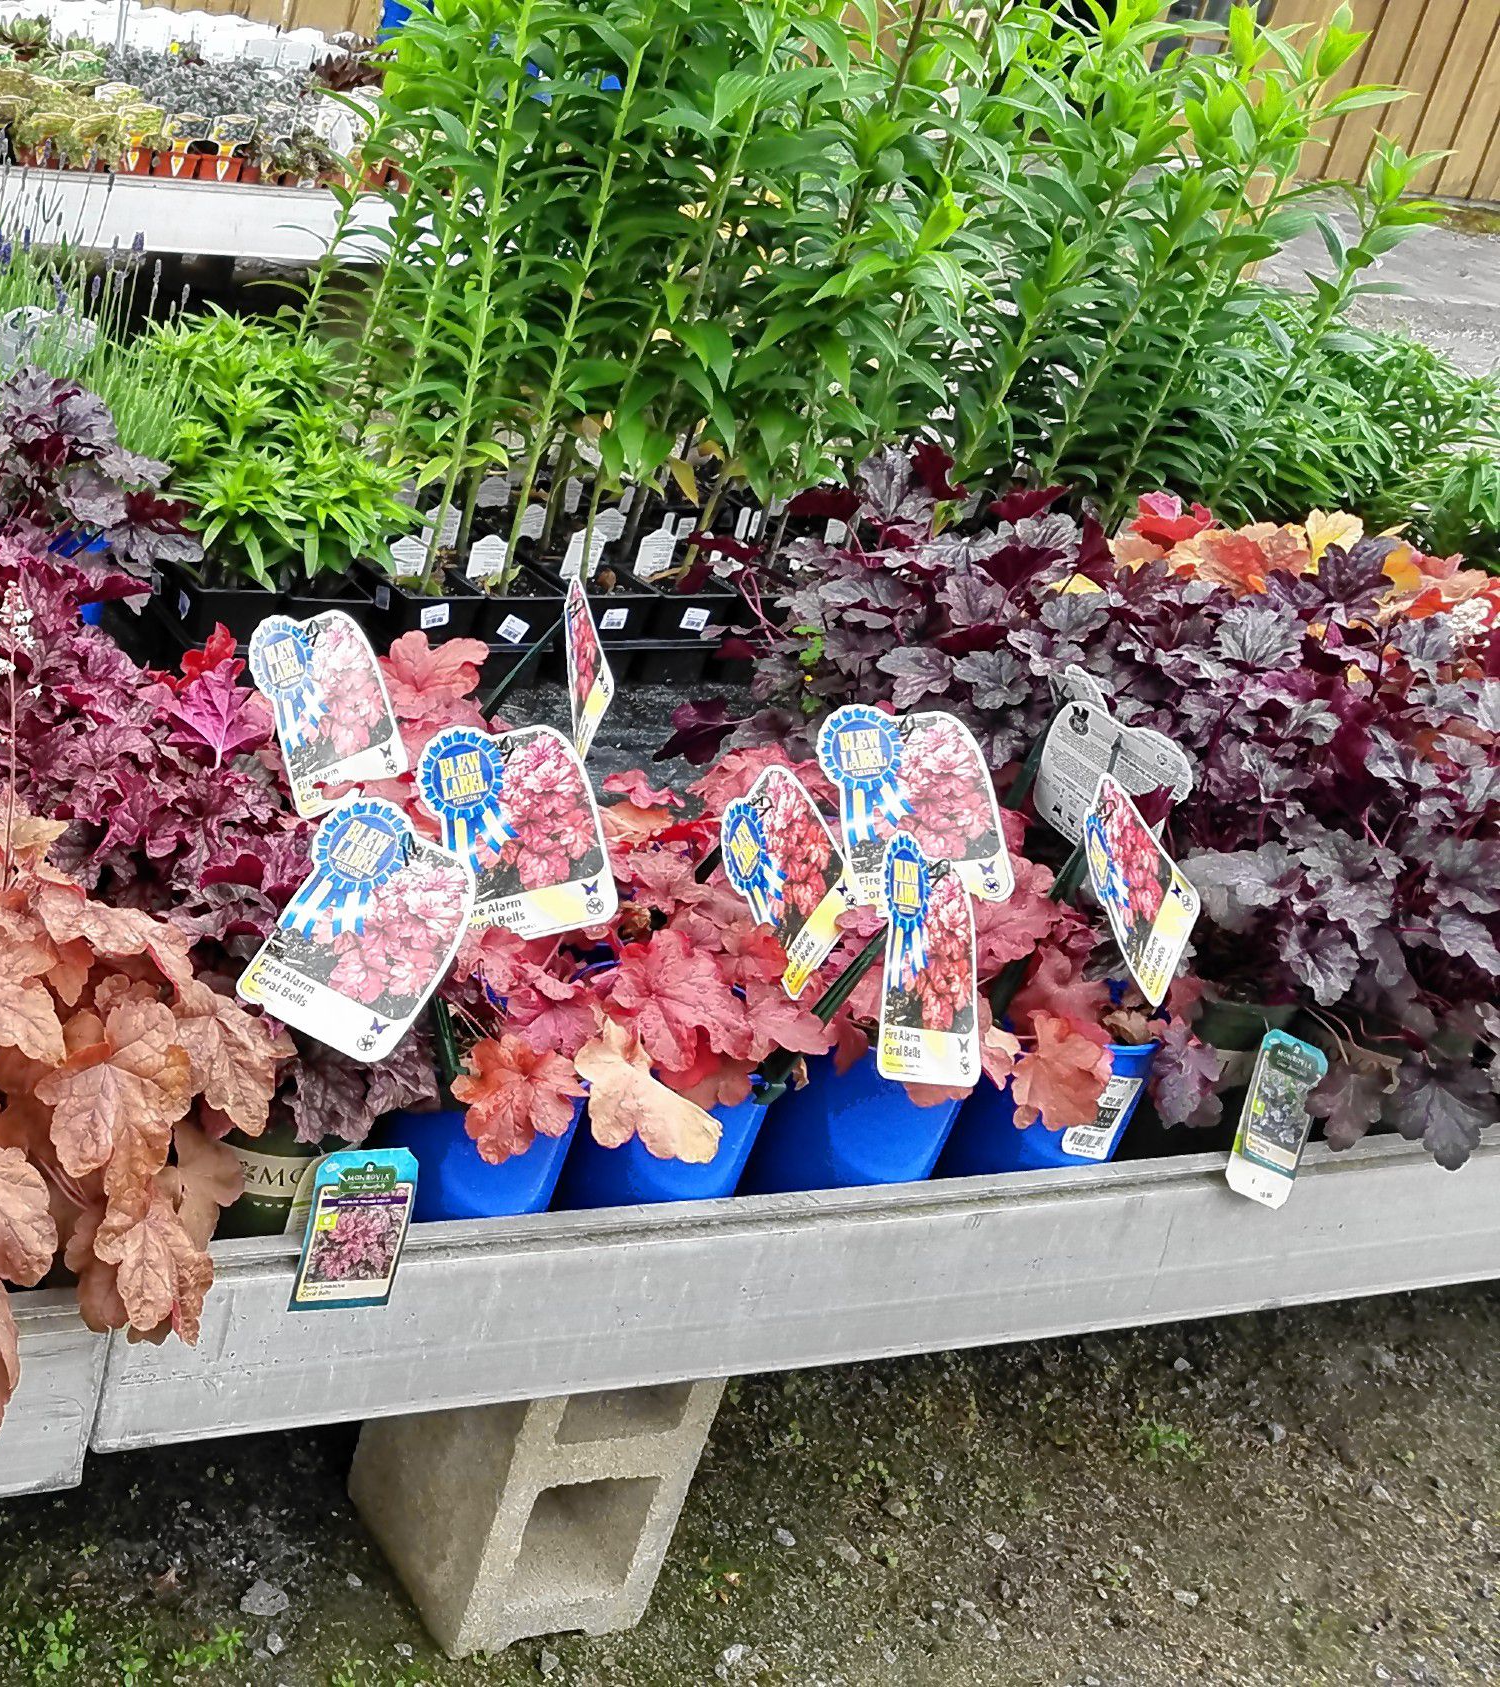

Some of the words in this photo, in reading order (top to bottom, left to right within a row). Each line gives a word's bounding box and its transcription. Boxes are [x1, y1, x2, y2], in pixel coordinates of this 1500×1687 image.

[838, 729, 881, 751] BLEW
[438, 751, 481, 779] BLEW
[840, 747, 888, 771] LABEL
[297, 778, 313, 791] Fire
[315, 768, 339, 780] Alarm
[441, 771, 488, 800] LABEL
[301, 790, 320, 802] Cora
[342, 820, 395, 856] BLEW
[331, 838, 380, 876] LABEL
[859, 876, 881, 886] Fire
[894, 859, 919, 885] BLEW
[894, 881, 921, 907] LABEL
[470, 907, 485, 918] ire
[488, 899, 521, 914] Alarm
[498, 911, 525, 925] Bells
[260, 959, 281, 976] Fire
[281, 972, 316, 994] Alarm
[252, 972, 281, 992] Coral
[281, 987, 308, 1007] Bells
[885, 1028, 898, 1039] Fire
[900, 1030, 920, 1042] Alarm
[884, 1043, 902, 1056] Coral
[904, 1046, 921, 1058] Bells
